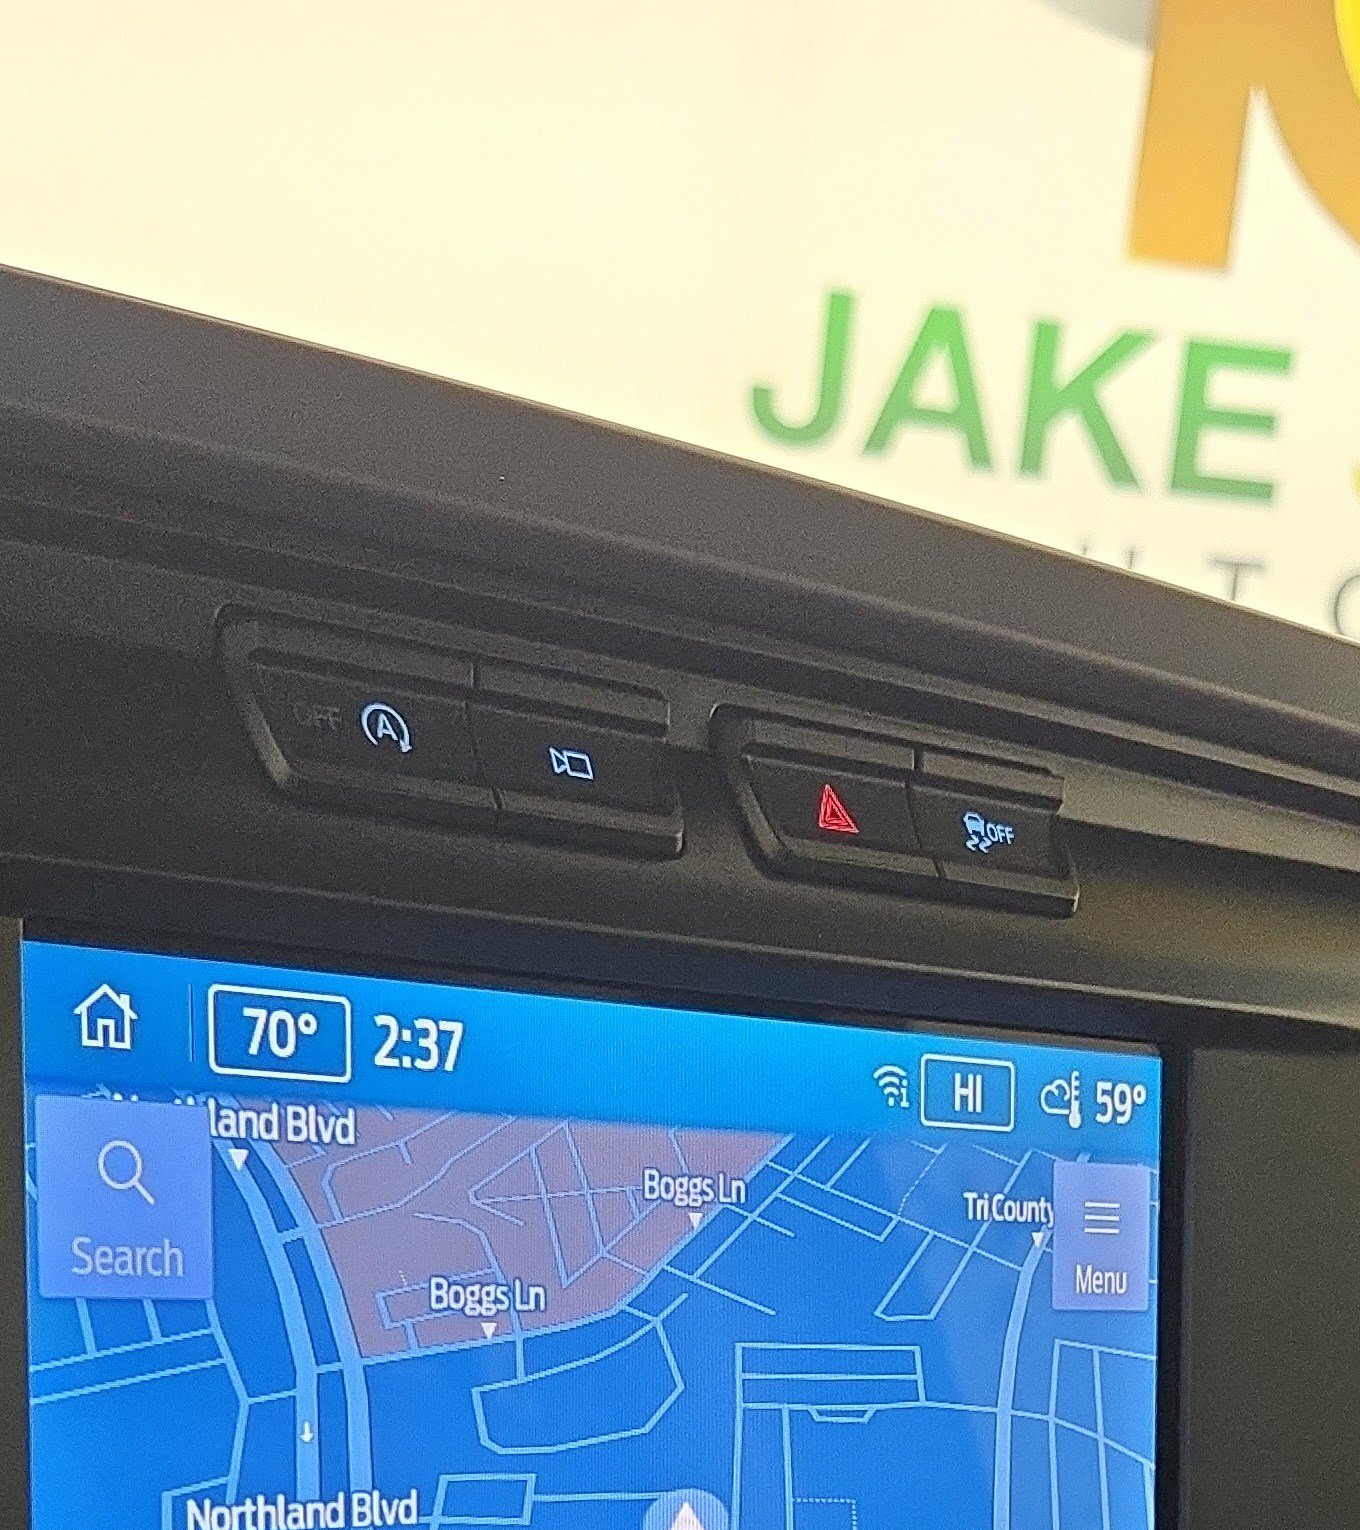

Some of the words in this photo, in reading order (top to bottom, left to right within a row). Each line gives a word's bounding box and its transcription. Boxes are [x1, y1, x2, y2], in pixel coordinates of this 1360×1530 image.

[750, 288, 1292, 506] JAKE
[986, 822, 1015, 846] OFF
[242, 1007, 319, 1059] 70°
[373, 1014, 465, 1072] 2:37
[953, 1073, 983, 1115] HI
[1095, 1081, 1148, 1125] 59°
[286, 1103, 357, 1146] Blvd
[643, 1167, 714, 1206] Boggs
[718, 1172, 746, 1204] Ln
[964, 1192, 990, 1220] Tri
[992, 1193, 1054, 1228] County
[71, 1236, 184, 1279] Search
[429, 1276, 509, 1316] Boggs
[514, 1279, 546, 1311] Ln
[1075, 1264, 1127, 1296] Menu
[350, 1488, 418, 1528] Blvd
